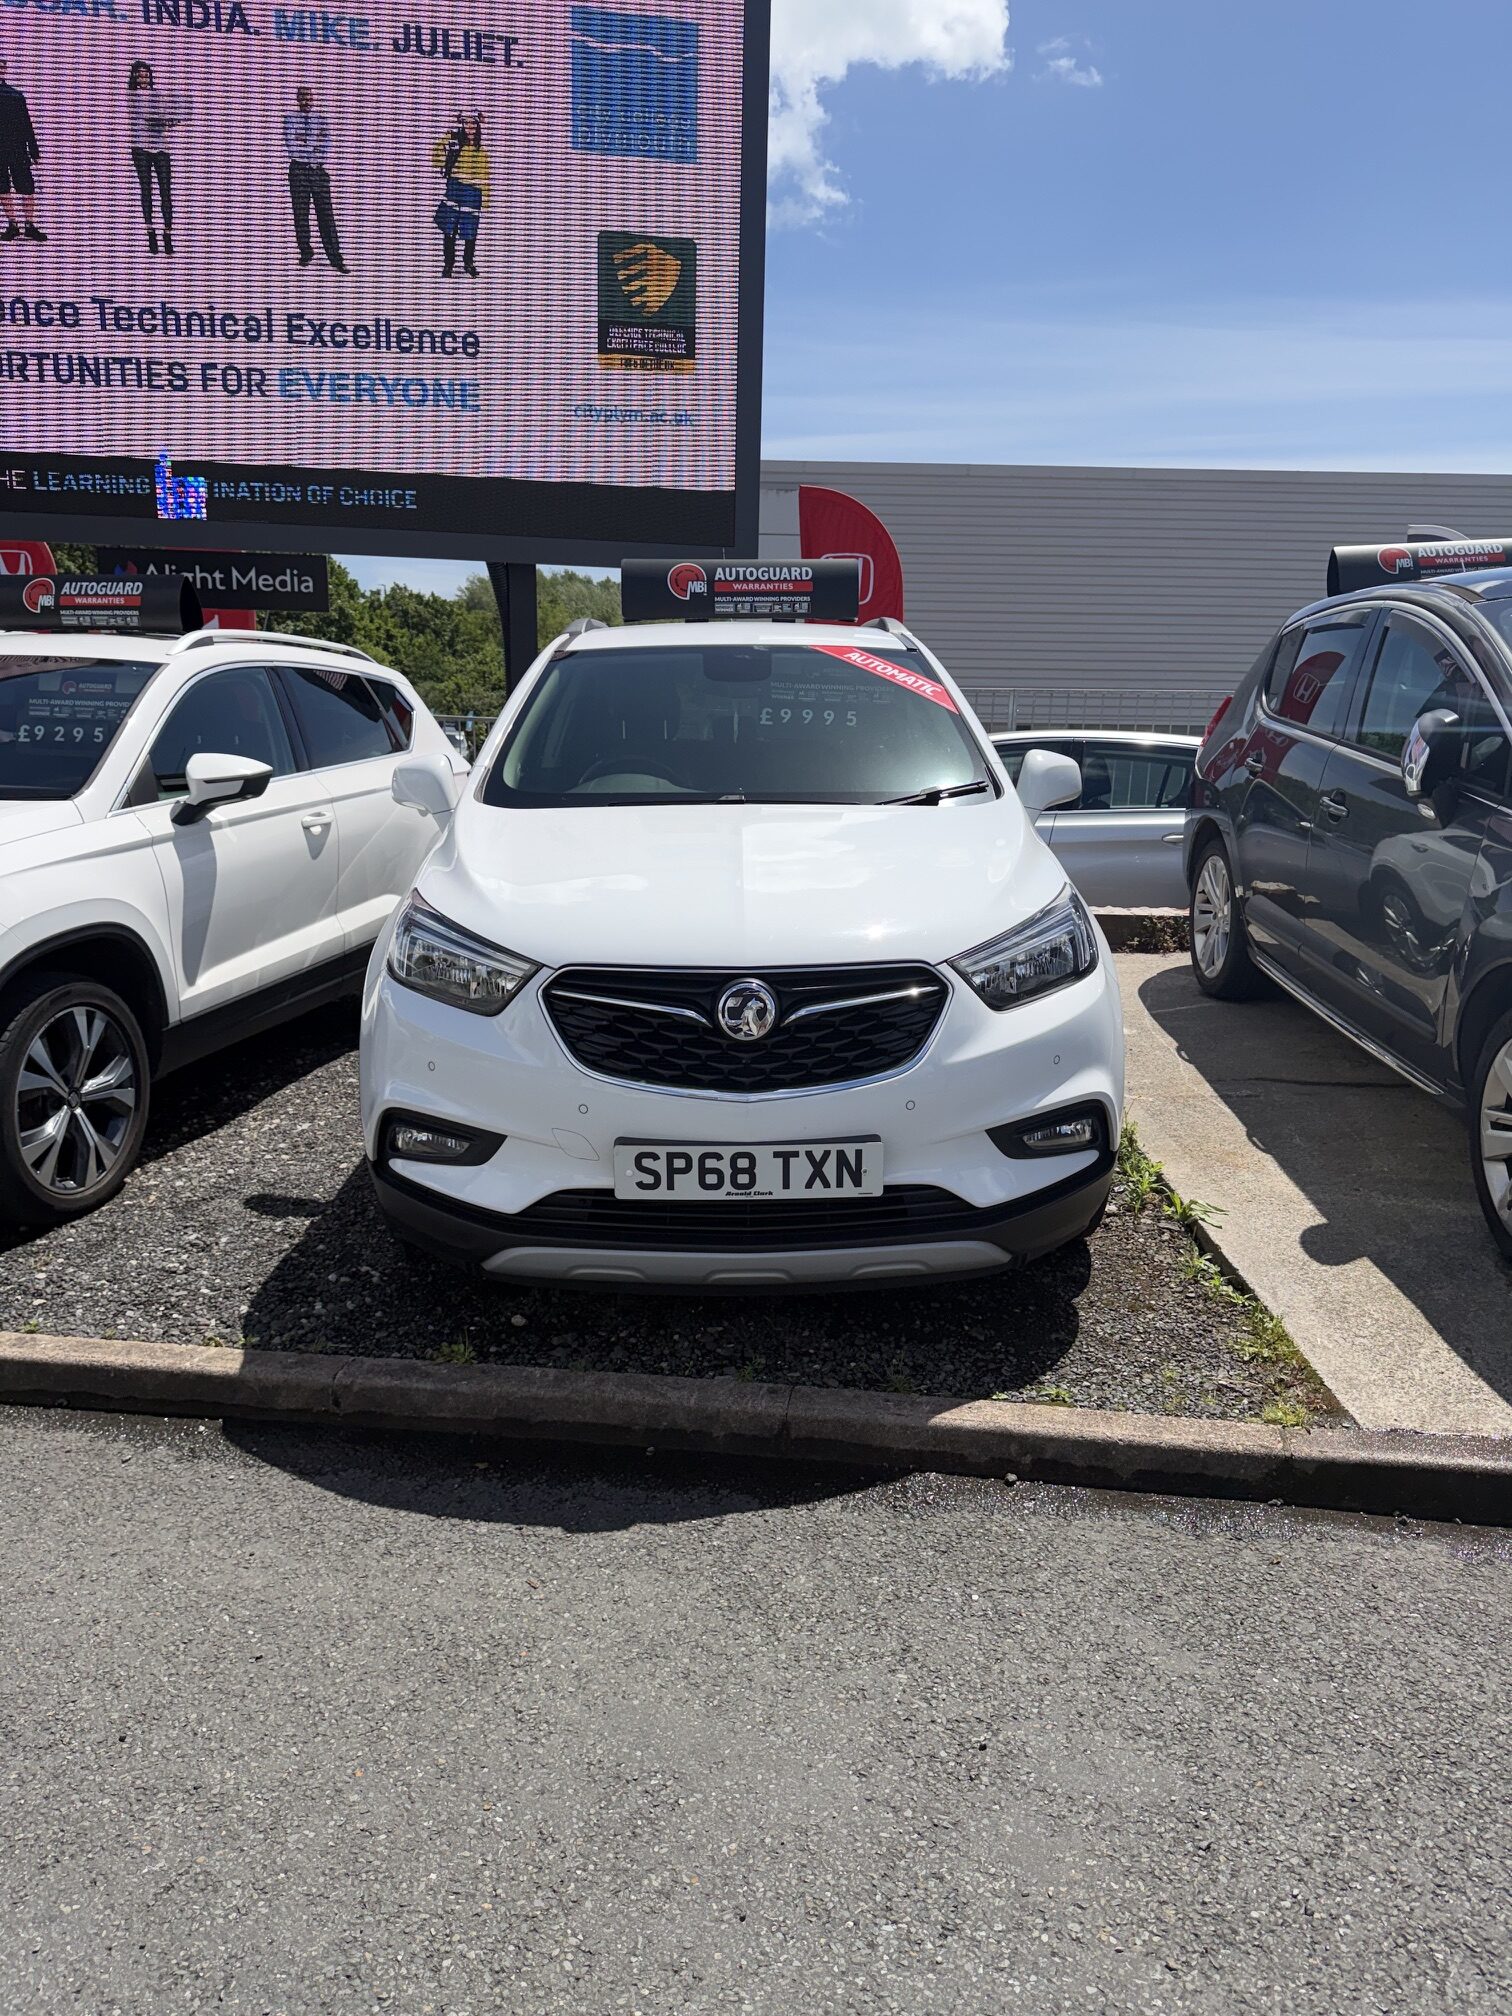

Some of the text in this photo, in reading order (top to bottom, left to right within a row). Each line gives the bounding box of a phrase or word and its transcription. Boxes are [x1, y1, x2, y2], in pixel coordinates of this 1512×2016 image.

[143, 0, 259, 36] INDIA.
[274, 9, 380, 50] MIKE.
[392, 23, 524, 67] JULIET.
[0, 295, 480, 358] nce Technical Excellence
[0, 350, 480, 412] RTUNITIES FOR EVERYONE
[33, 471, 151, 494] LEARNING
[306, 485, 334, 504] OF
[340, 487, 417, 509] CHOICE
[1418, 544, 1503, 558] AUTOGUARD
[1435, 556, 1489, 564] WARRANTIES
[231, 566, 314, 593] Media
[714, 567, 813, 581] AUTOGUARD
[60, 582, 143, 595] AUTOGUARD
[843, 651, 943, 696] AUTOMATIC
[760, 707, 857, 726] £9995
[18, 724, 104, 743] £9295
[634, 1149, 863, 1191] SP68 TXN
